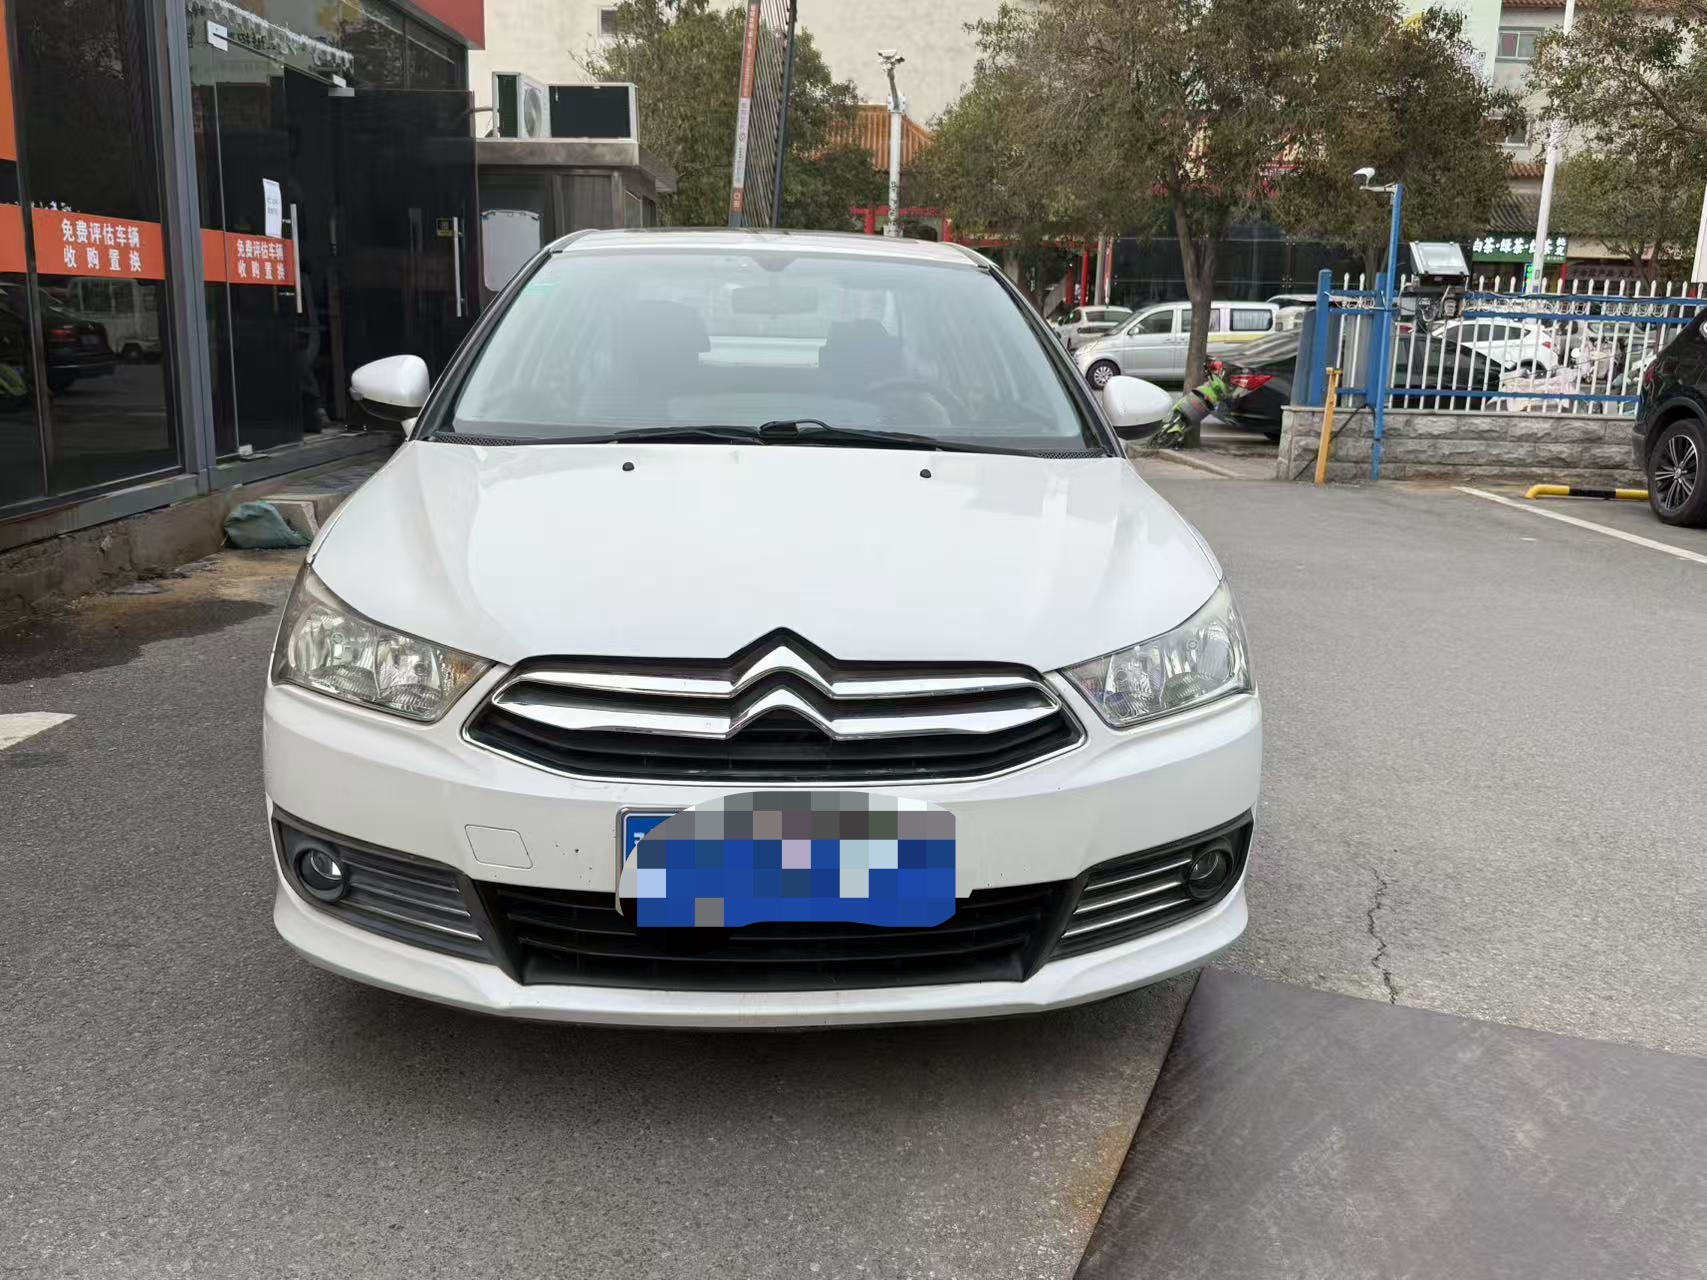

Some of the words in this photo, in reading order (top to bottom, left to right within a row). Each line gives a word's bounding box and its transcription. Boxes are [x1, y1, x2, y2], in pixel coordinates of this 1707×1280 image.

[61, 218, 140, 248] 免费评估车辆
[63, 245, 142, 272] 收购置换
[236, 239, 284, 261] 免费评估车辆
[237, 259, 285, 281] 收购置换
